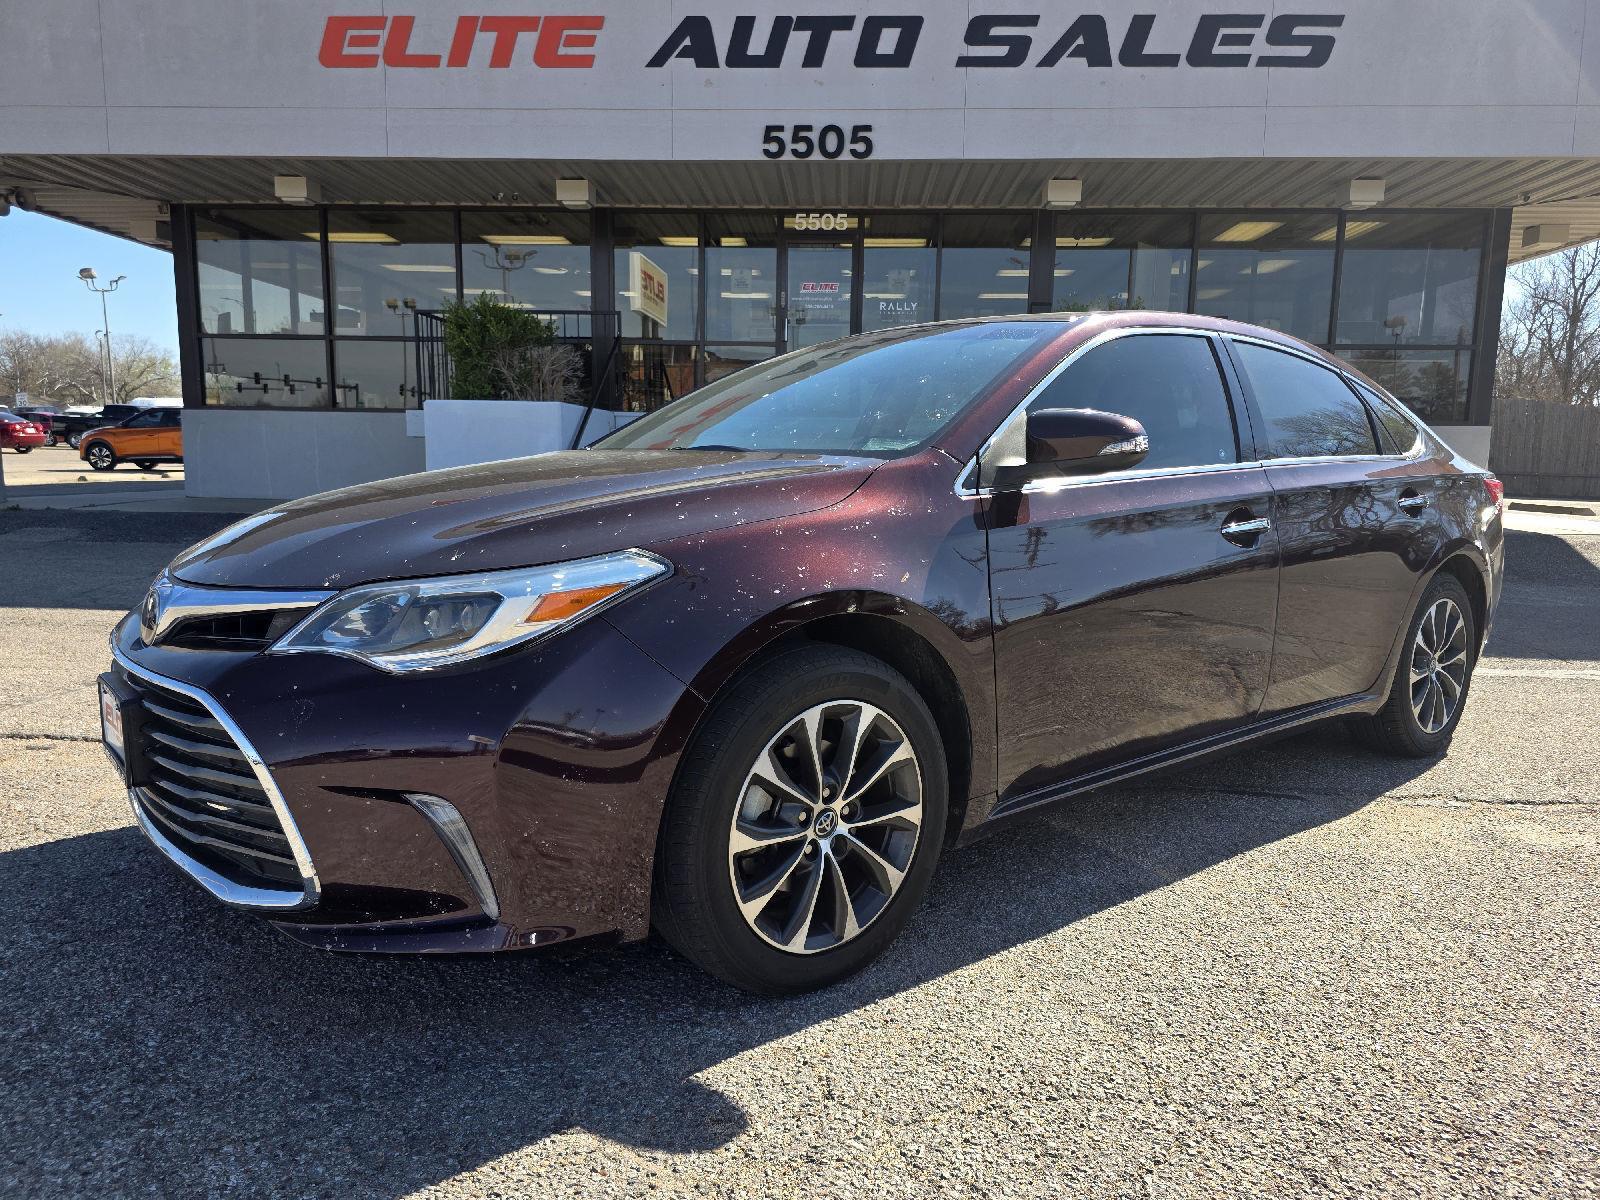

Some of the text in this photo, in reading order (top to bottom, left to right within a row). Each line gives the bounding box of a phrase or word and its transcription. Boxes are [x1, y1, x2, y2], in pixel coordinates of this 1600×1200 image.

[318, 14, 1345, 69] ELITE AUTO SALES
[762, 124, 874, 160] 5505
[794, 213, 848, 231] 5505
[880, 301, 918, 311] RALLY
